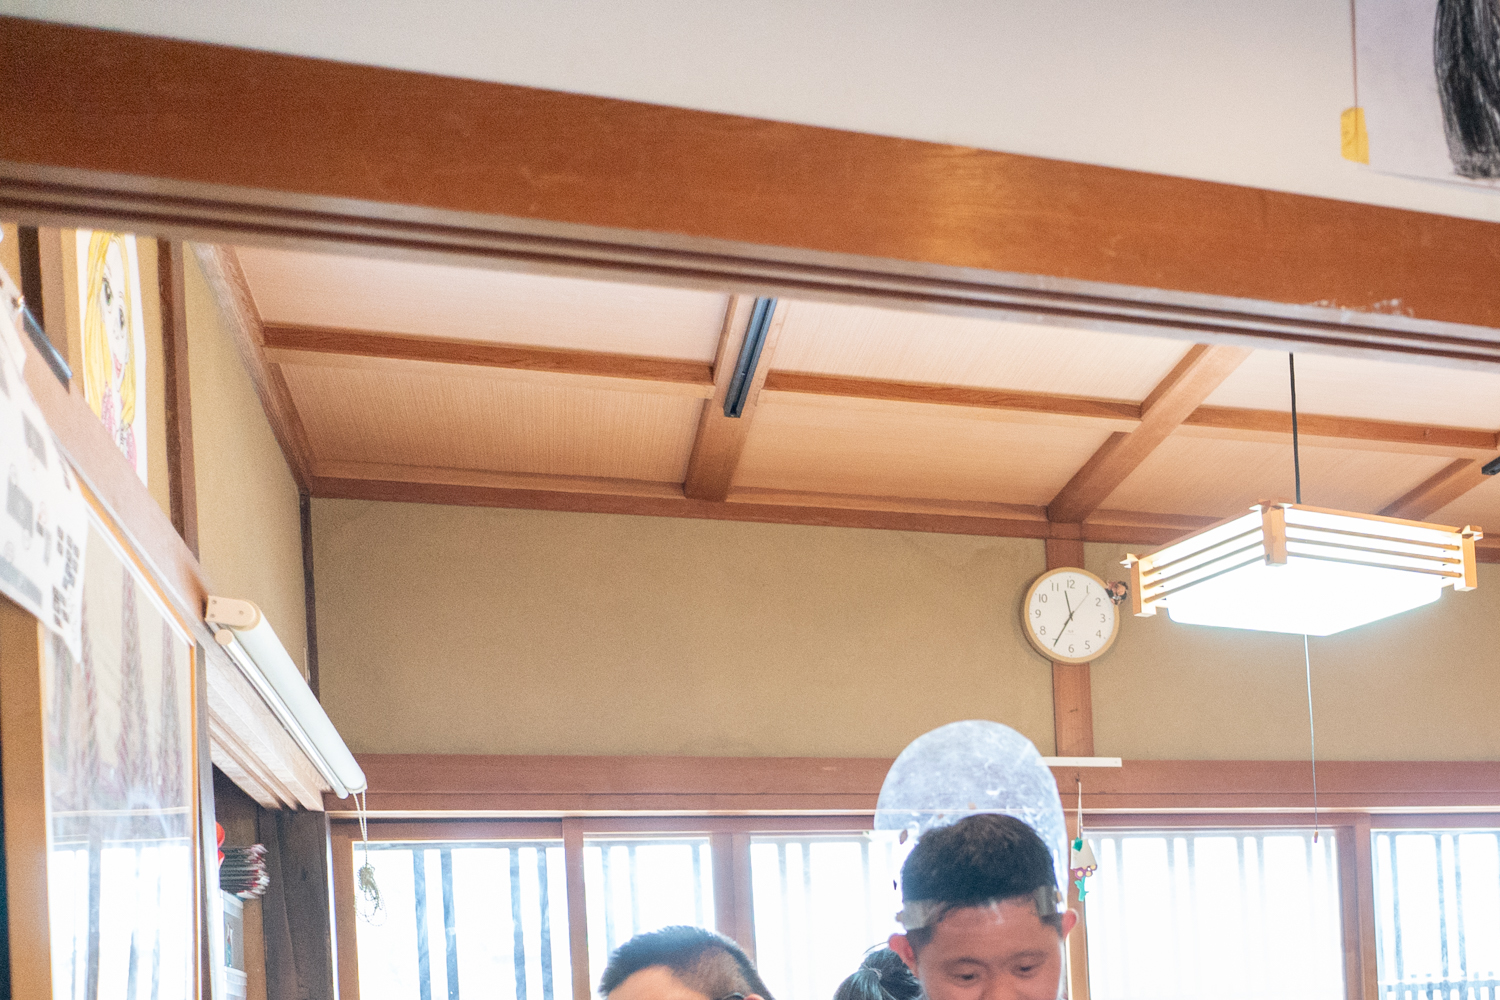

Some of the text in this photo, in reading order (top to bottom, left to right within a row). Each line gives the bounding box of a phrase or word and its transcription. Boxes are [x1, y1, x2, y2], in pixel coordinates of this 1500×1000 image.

[1051, 582, 1059, 592] 11
[1066, 579, 1076, 589] 12
[1038, 593, 1048, 603] 10
[1095, 597, 1101, 607] 2
[1034, 609, 1041, 618] 9
[1099, 613, 1106, 623] 3
[1039, 625, 1046, 635] 8
[1095, 629, 1102, 638] 4
[1068, 644, 1074, 653] 6
[1084, 640, 1090, 650] 5
